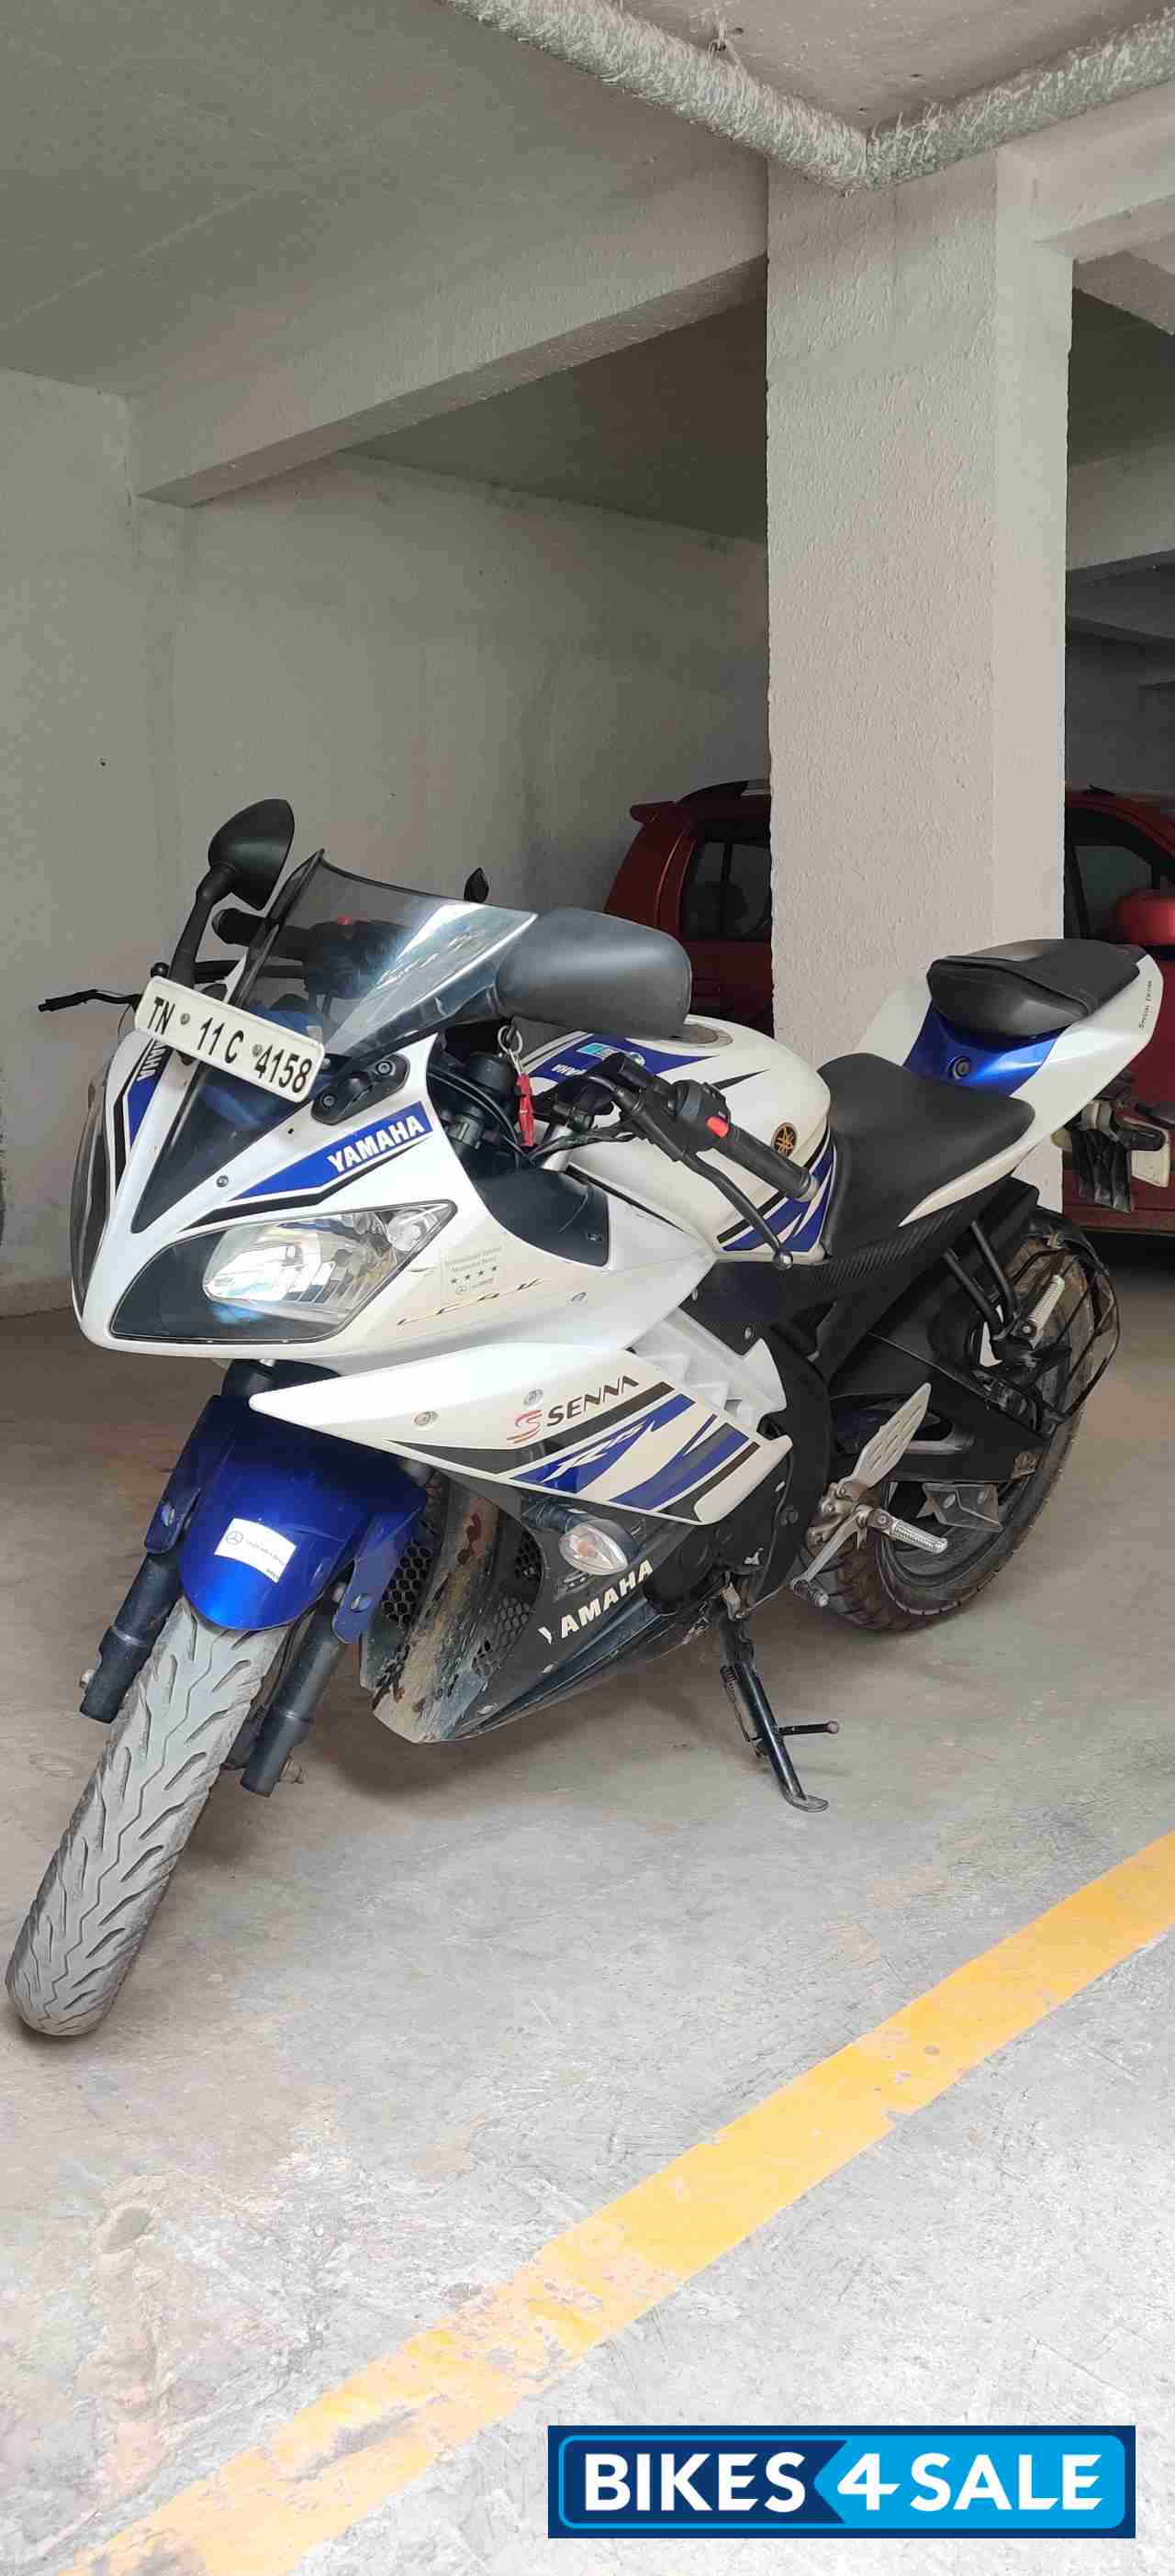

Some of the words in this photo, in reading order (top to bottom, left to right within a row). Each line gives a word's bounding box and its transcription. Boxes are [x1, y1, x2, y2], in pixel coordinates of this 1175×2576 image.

[148, 997, 176, 1035] TN
[253, 1043, 313, 1094] 4158
[327, 1115, 425, 1173] YAMAHA
[547, 1375, 640, 1427] SENNA
